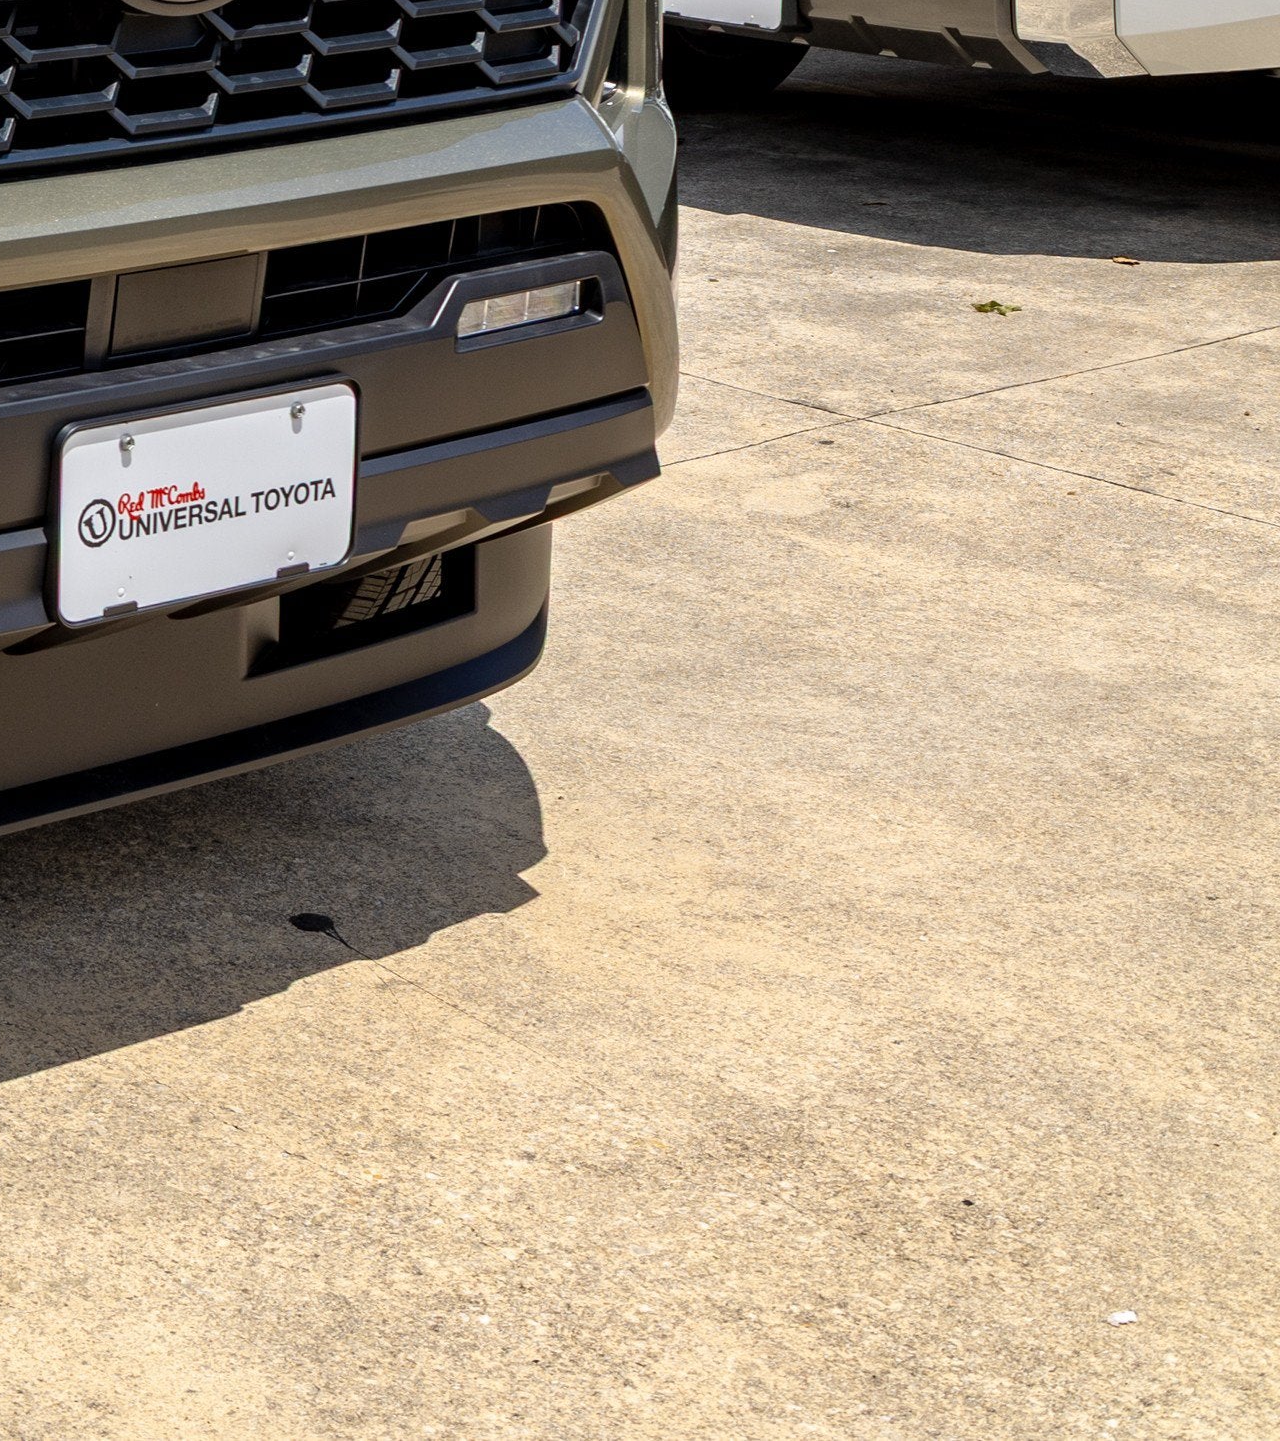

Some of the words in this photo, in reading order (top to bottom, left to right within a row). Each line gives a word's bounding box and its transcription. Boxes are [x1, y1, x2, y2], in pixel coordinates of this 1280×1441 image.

[117, 491, 145, 520] Red
[147, 480, 206, 510] McCombs
[117, 493, 247, 541] UNIVERSAL
[250, 477, 337, 515] TOYOTA
